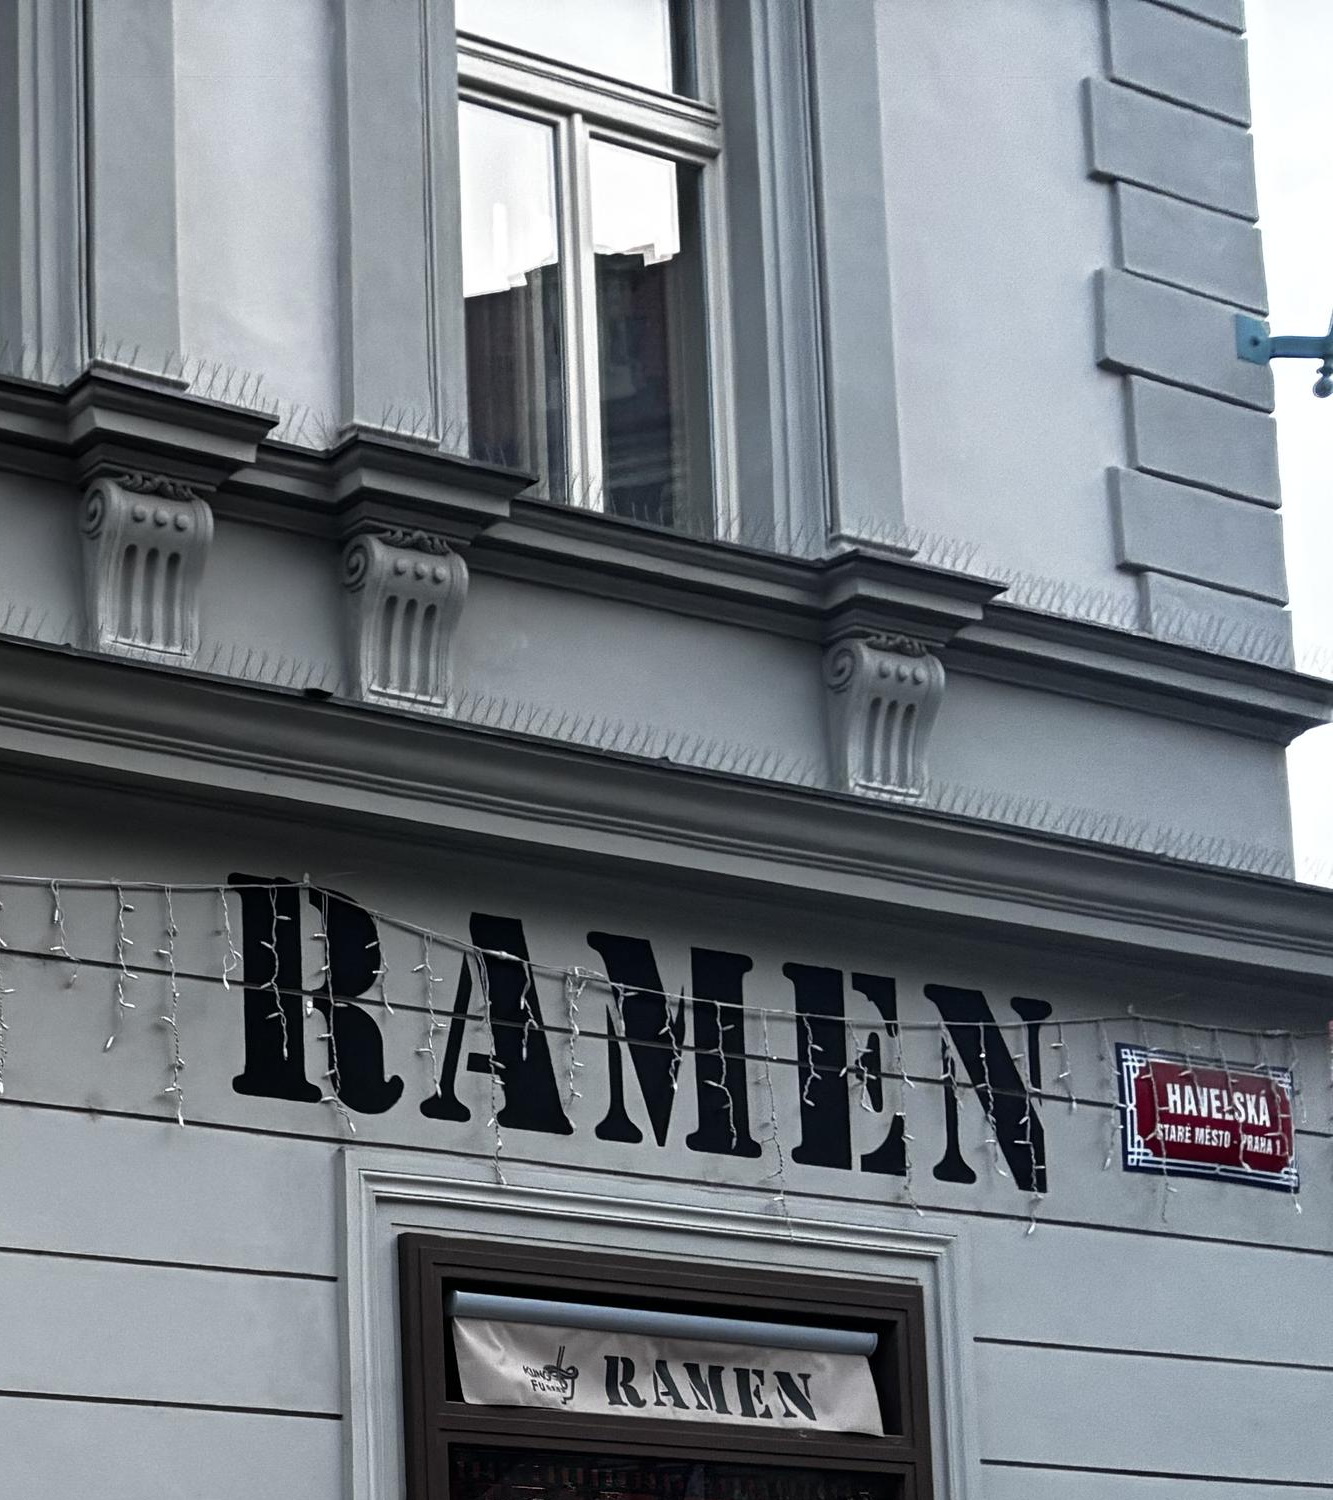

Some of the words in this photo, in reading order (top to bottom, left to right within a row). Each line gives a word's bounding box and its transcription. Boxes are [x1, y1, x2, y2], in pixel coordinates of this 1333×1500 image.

[227, 872, 1052, 1193] RAMEN
[1166, 1083, 1271, 1127] HAVELSKÁ
[1156, 1123, 1191, 1143] STARÉ
[1195, 1124, 1231, 1148] MĚSTO
[1241, 1134, 1273, 1155] PRAHA
[1276, 1140, 1281, 1156] 1
[604, 1355, 817, 1421] RAMEN
